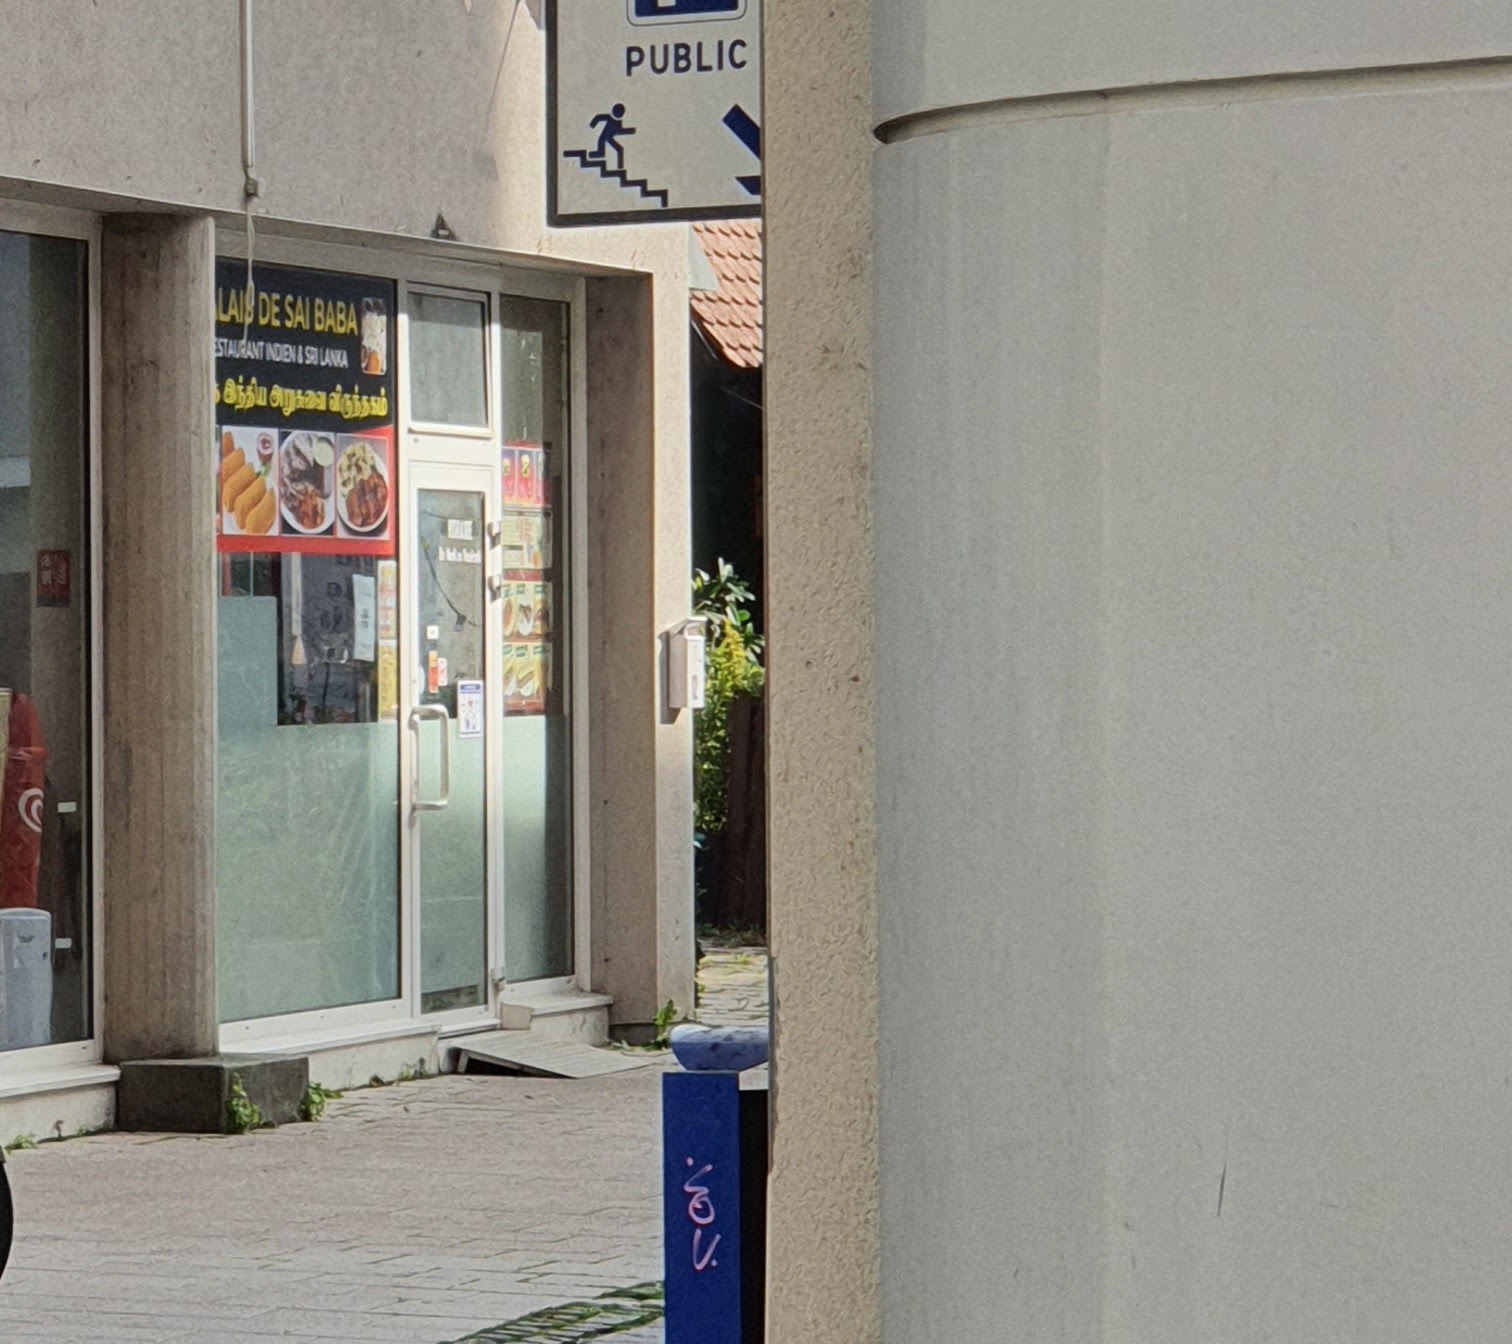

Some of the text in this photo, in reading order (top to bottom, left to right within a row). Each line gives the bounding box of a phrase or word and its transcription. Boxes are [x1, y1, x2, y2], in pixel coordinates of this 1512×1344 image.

[625, 39, 747, 77] PUBLIC
[258, 291, 281, 327] DE
[285, 294, 310, 331] SAI
[314, 299, 358, 336] BABA
[265, 342, 297, 363] INDIEN
[320, 347, 349, 369] LANKA
